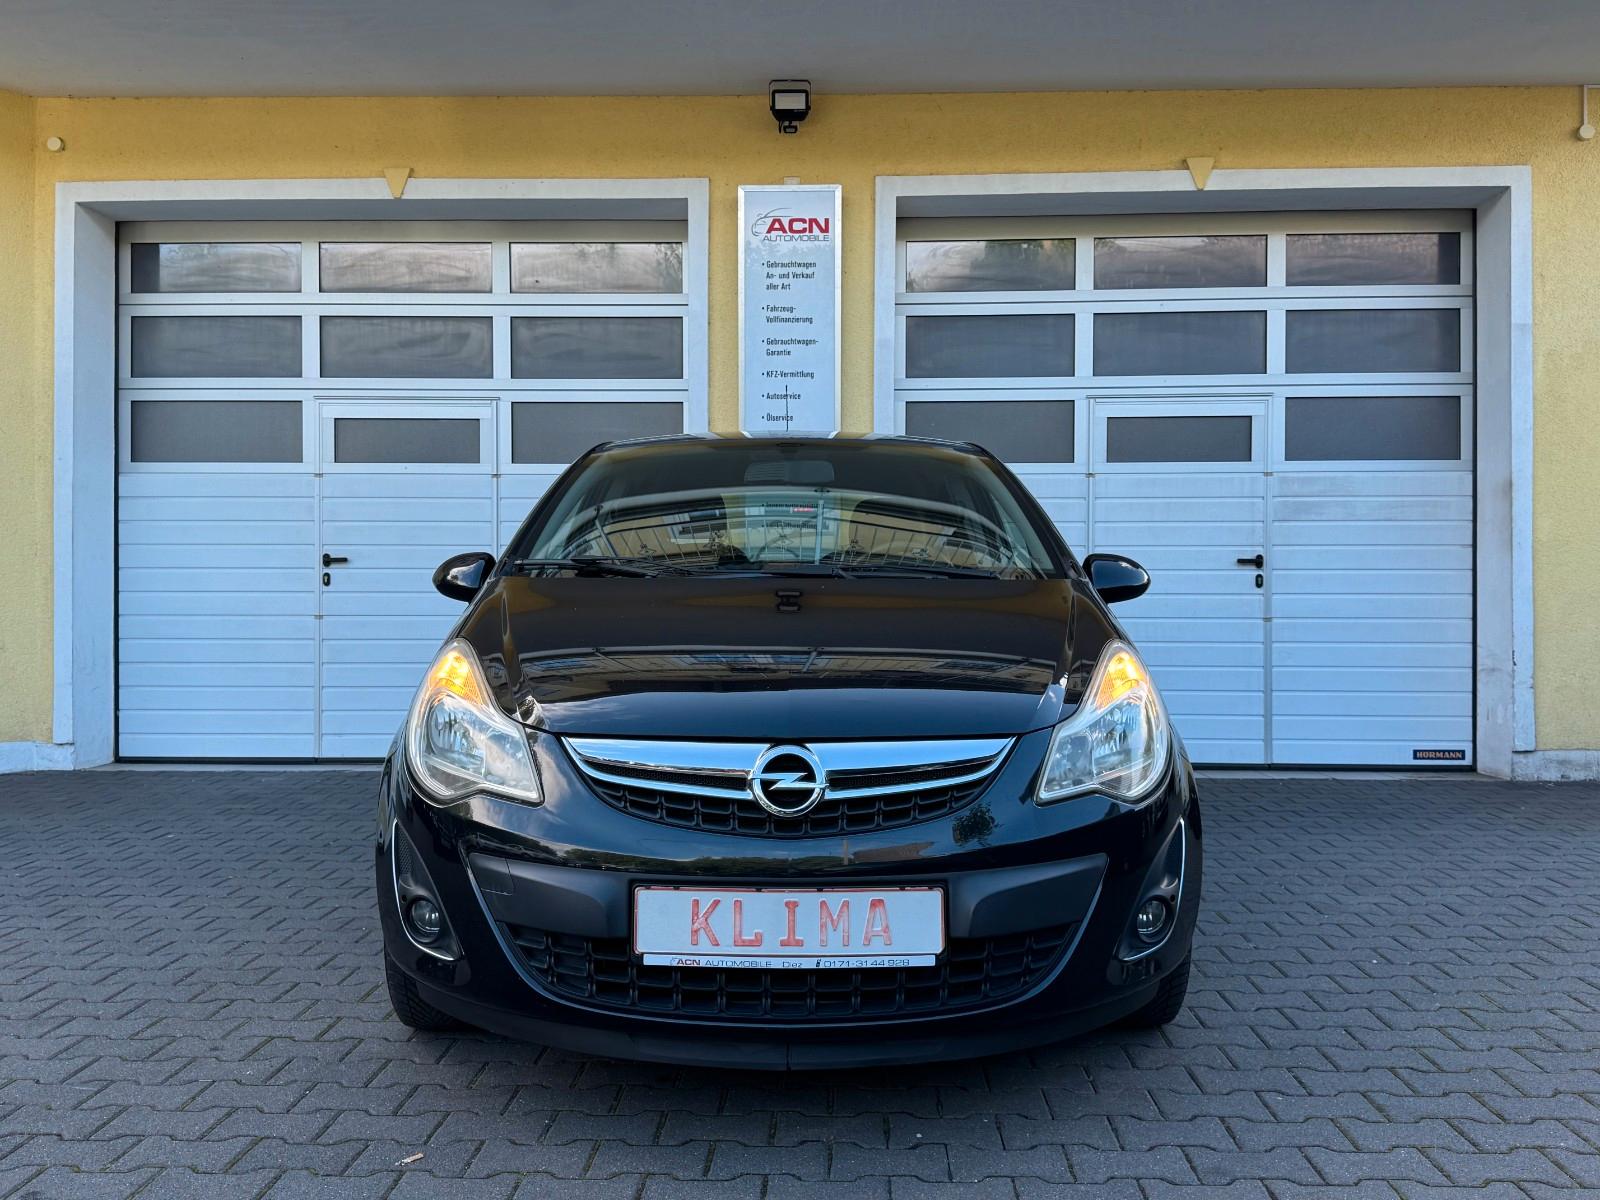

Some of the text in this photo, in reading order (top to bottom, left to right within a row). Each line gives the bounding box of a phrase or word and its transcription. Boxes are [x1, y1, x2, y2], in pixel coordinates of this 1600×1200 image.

[766, 218, 830, 234] ACN
[766, 261, 817, 270] Gebrauchtwagen
[766, 272, 815, 280] An- und Verkauf
[766, 283, 791, 291] aller Art
[766, 305, 797, 313] Fahrzeug-
[766, 316, 813, 324] Vollfinanzierung
[766, 337, 819, 346] Gebrauchtwagen-
[766, 348, 792, 356] Garantie
[766, 370, 815, 379] KFZ-Vermittlung
[766, 392, 801, 400] Autoservice
[690, 898, 893, 947] KLIMA
[705, 959, 772, 968] AUTOMOBILE
